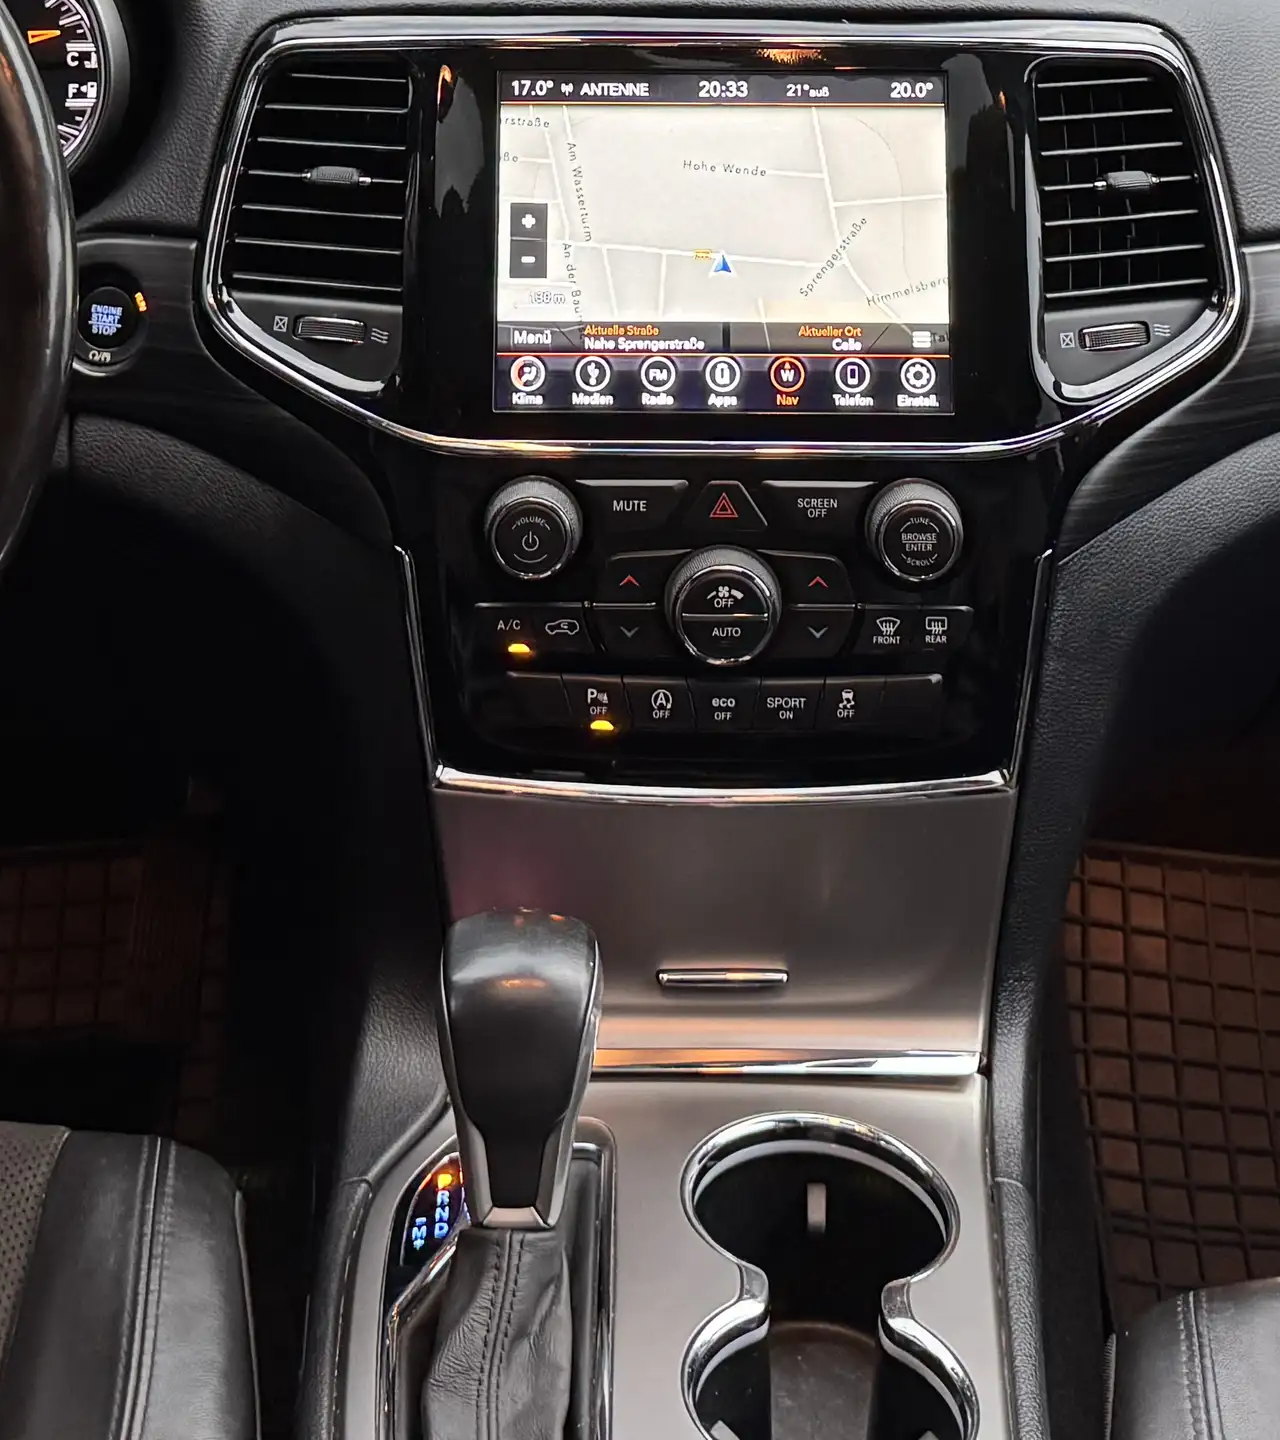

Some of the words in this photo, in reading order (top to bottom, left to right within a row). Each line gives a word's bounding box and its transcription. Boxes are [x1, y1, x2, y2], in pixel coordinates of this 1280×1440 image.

[66, 51, 80, 67] C
[68, 83, 80, 99] F
[511, 79, 554, 97] 17.0°
[579, 82, 650, 98] ANTENNE
[698, 80, 749, 98] 20:33
[889, 81, 934, 99] 20.0°
[90, 303, 123, 317] ENGINE
[91, 312, 121, 325] START
[91, 325, 118, 336] STOP
[513, 329, 552, 345] Menü
[583, 324, 625, 336] Aktuelle
[626, 324, 660, 337] Straße
[798, 325, 843, 338] Aktueller
[844, 325, 862, 337] Ort
[617, 336, 705, 353] Sprengerstraße
[831, 338, 862, 352] Celle
[648, 368, 668, 381] FM
[511, 392, 544, 406] Klima
[571, 392, 614, 406] Medien
[641, 392, 674, 406] Radio
[707, 393, 738, 408] Apps
[776, 394, 800, 406] Nav
[832, 393, 874, 407] Telefon
[896, 394, 940, 408] Einstell.
[612, 499, 647, 512] MUTE
[797, 497, 838, 509] SCREEN
[807, 508, 828, 519] OFF
[516, 515, 547, 527] VOLUME
[909, 516, 930, 526] TUNE
[901, 532, 938, 542] BROWSE
[905, 543, 934, 553] ENTER
[906, 556, 934, 568] SCROLL
[713, 598, 735, 609] OFF
[496, 619, 521, 631] A/C
[711, 626, 742, 638] AUTO
[872, 635, 901, 646] FRONT
[925, 634, 947, 645] REAR
[711, 696, 736, 708] eco
[766, 697, 807, 709] SPORT
[589, 706, 608, 716] OFF
[652, 709, 671, 720] OFF
[713, 711, 733, 721] OFF
[779, 710, 794, 720] ON
[836, 708, 855, 719] OFF
[436, 1189, 450, 1206] R
[435, 1205, 450, 1222] N
[411, 1225, 427, 1241] M
[434, 1221, 449, 1239] D
